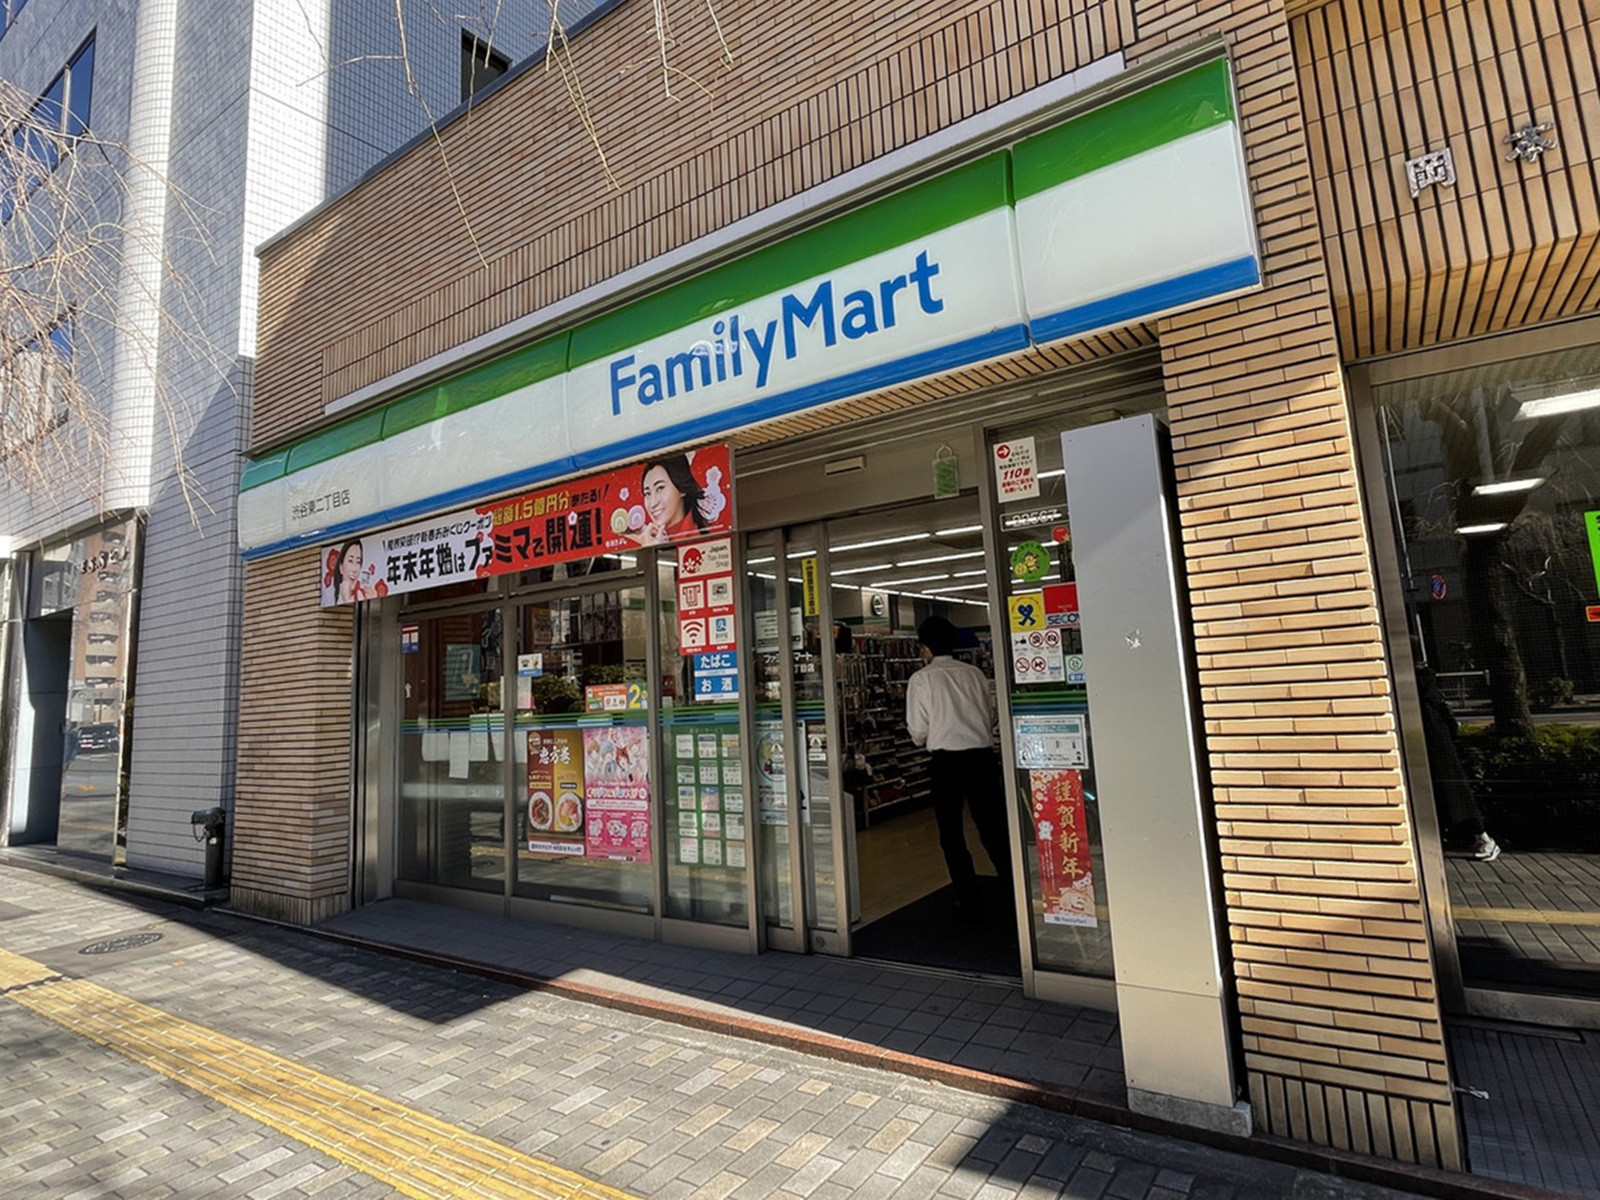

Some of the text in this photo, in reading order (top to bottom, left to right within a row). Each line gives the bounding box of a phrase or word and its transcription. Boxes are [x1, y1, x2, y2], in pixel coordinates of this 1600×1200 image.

[610, 250, 944, 417] FamilyMart
[292, 488, 350, 520] 渋谷東二丁目店
[700, 654, 731, 668] たばこ
[538, 745, 571, 765] 恵方巻
[1053, 780, 1084, 879] 謹賀新年
